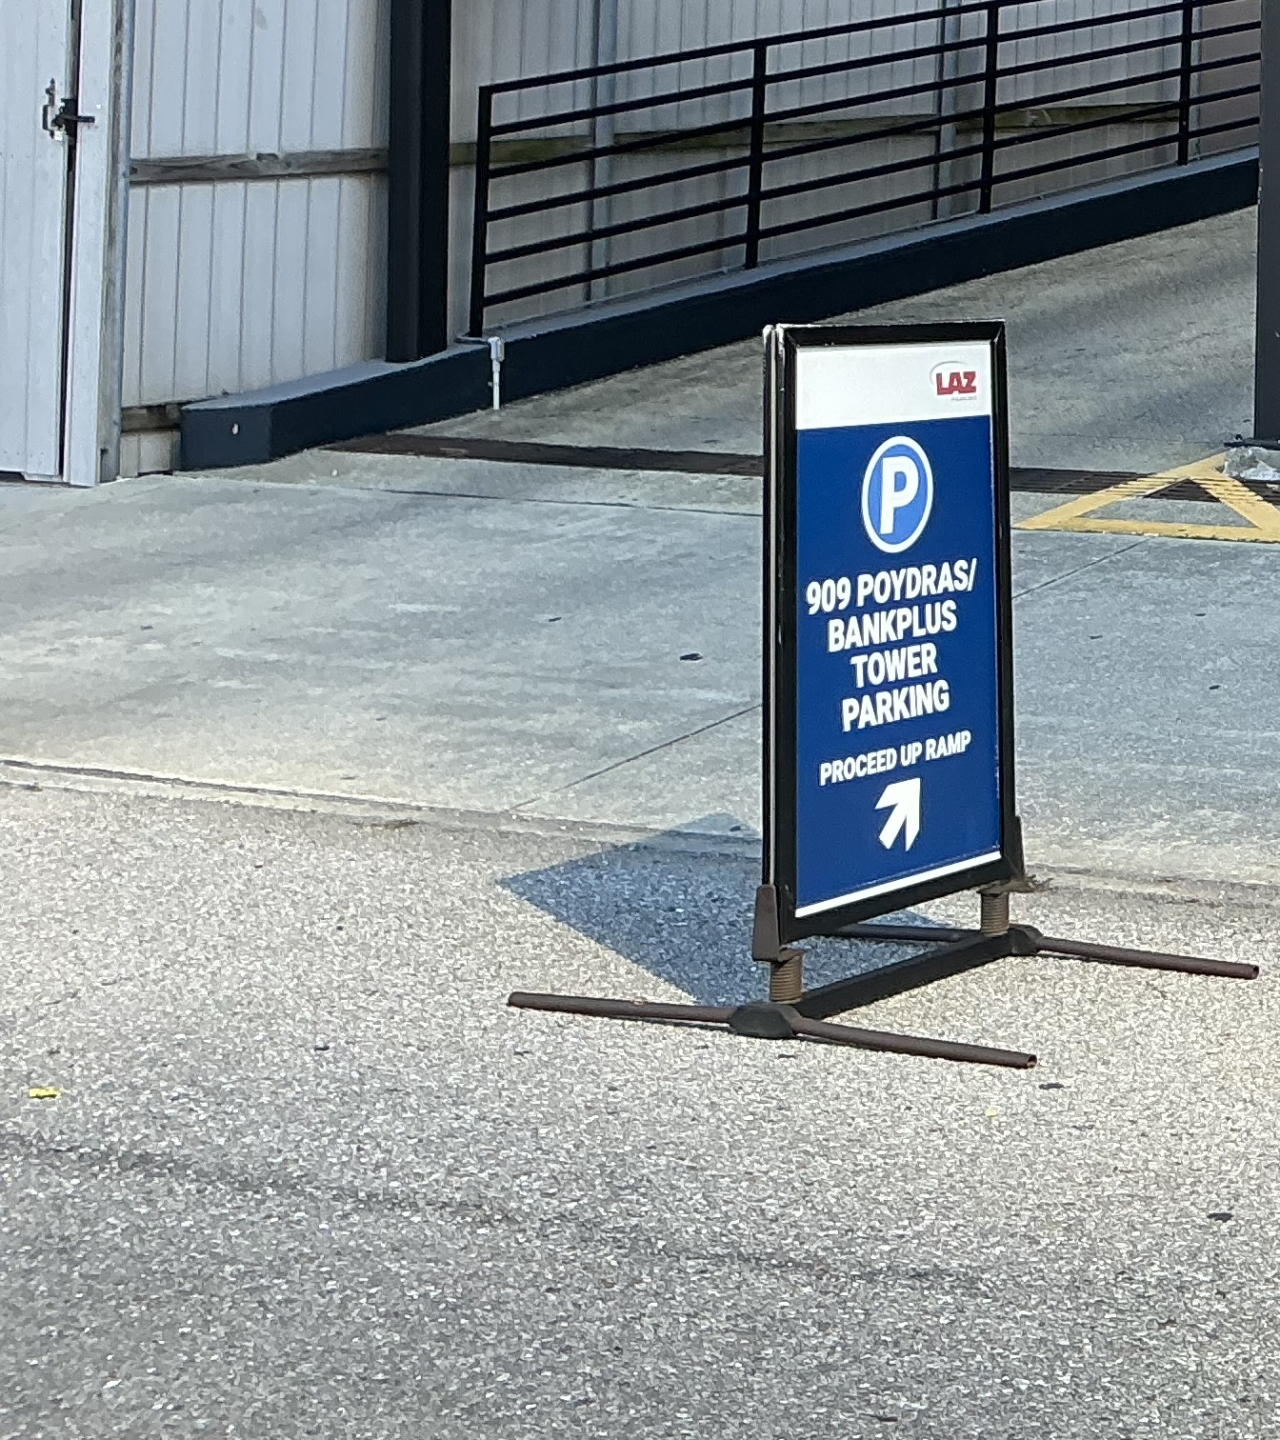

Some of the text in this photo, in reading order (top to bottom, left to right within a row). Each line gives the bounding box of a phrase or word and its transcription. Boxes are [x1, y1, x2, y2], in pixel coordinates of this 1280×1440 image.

[936, 371, 976, 395] LAZ
[807, 557, 978, 615] 909 POYDRAS/
[829, 600, 957, 652] BANKPLUS
[851, 643, 938, 688] TOWER
[843, 680, 950, 731] PARKING
[820, 731, 971, 785] PROCEED UP RAMP
